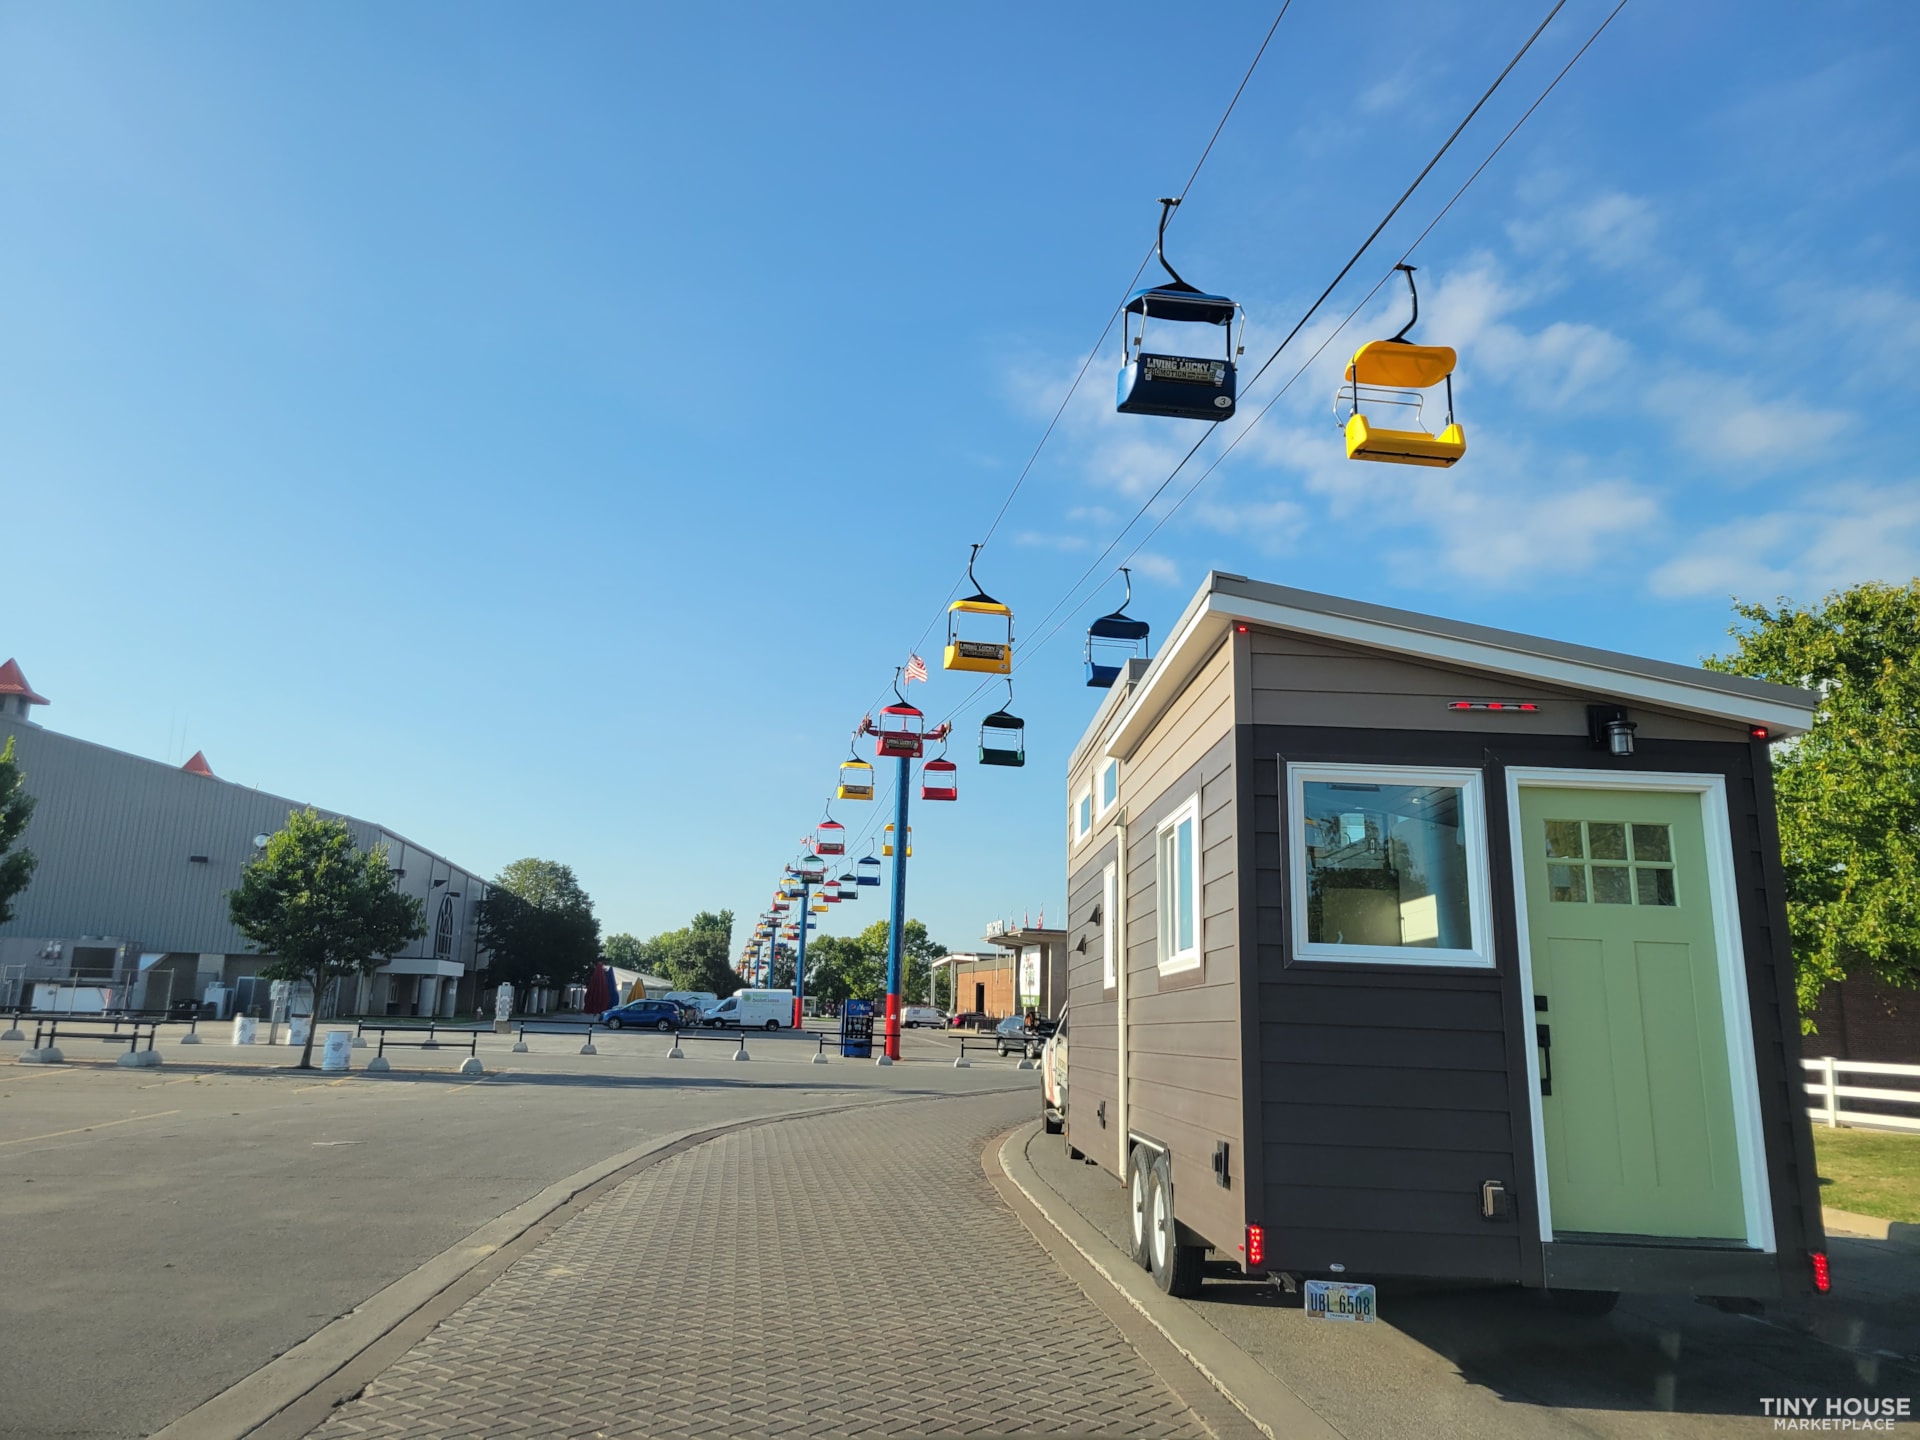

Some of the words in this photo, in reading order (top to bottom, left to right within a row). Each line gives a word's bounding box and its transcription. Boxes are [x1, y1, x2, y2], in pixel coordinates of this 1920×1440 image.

[1146, 357, 1177, 371] LIVING
[1179, 360, 1210, 373] LUCKY
[1311, 1293, 1333, 1313] UBL
[1339, 1295, 1370, 1315] 6508
